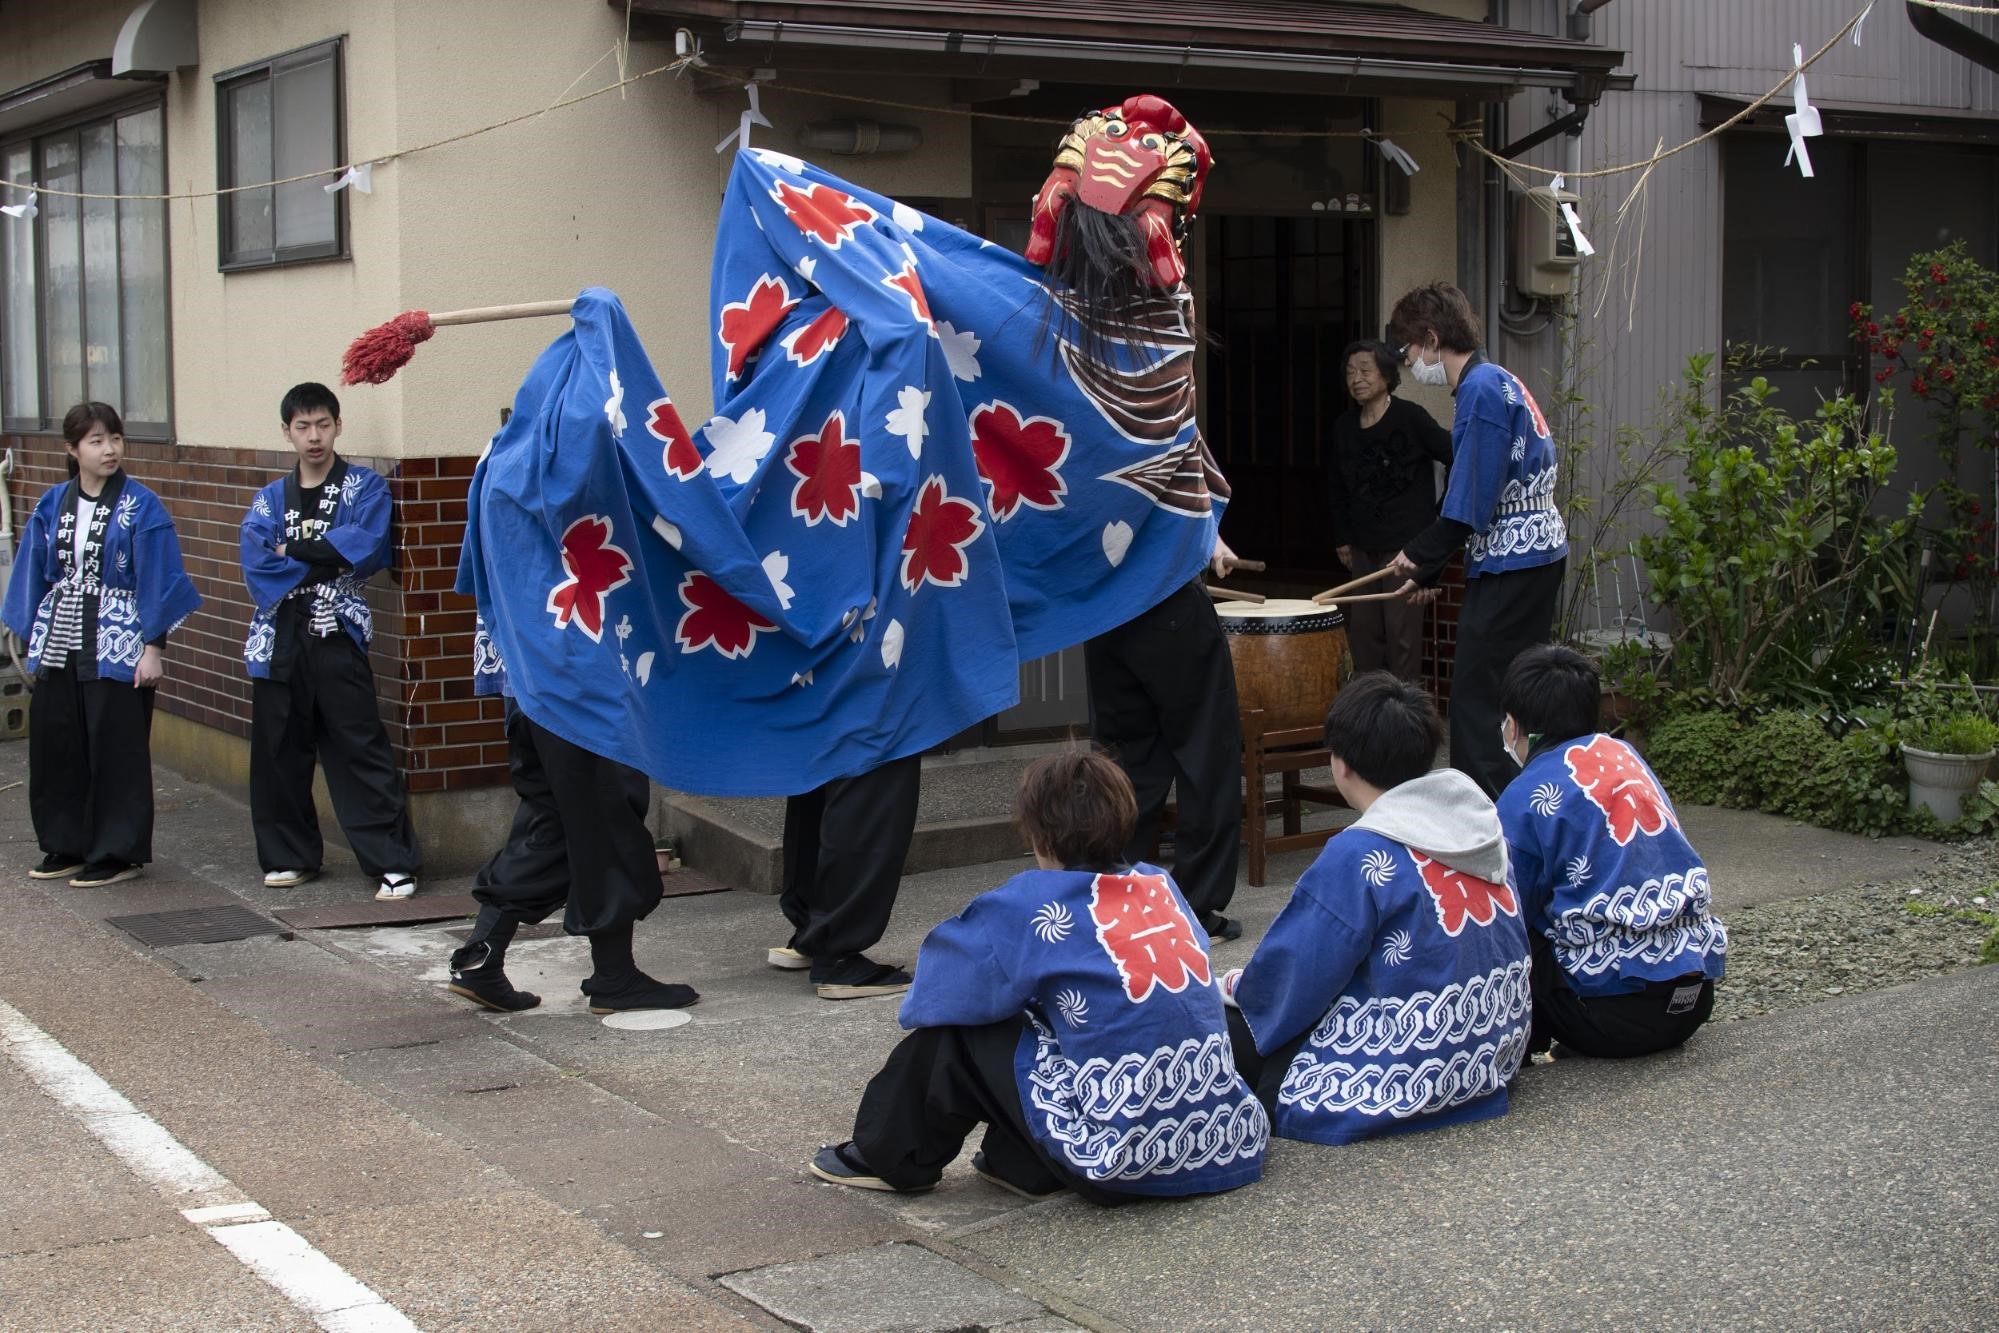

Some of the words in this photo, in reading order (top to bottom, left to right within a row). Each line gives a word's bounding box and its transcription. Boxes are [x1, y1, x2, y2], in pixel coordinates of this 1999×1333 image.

[284, 509, 301, 541] 中町
[1563, 733, 1681, 847] 祭
[1087, 869, 1212, 1004] 祭
